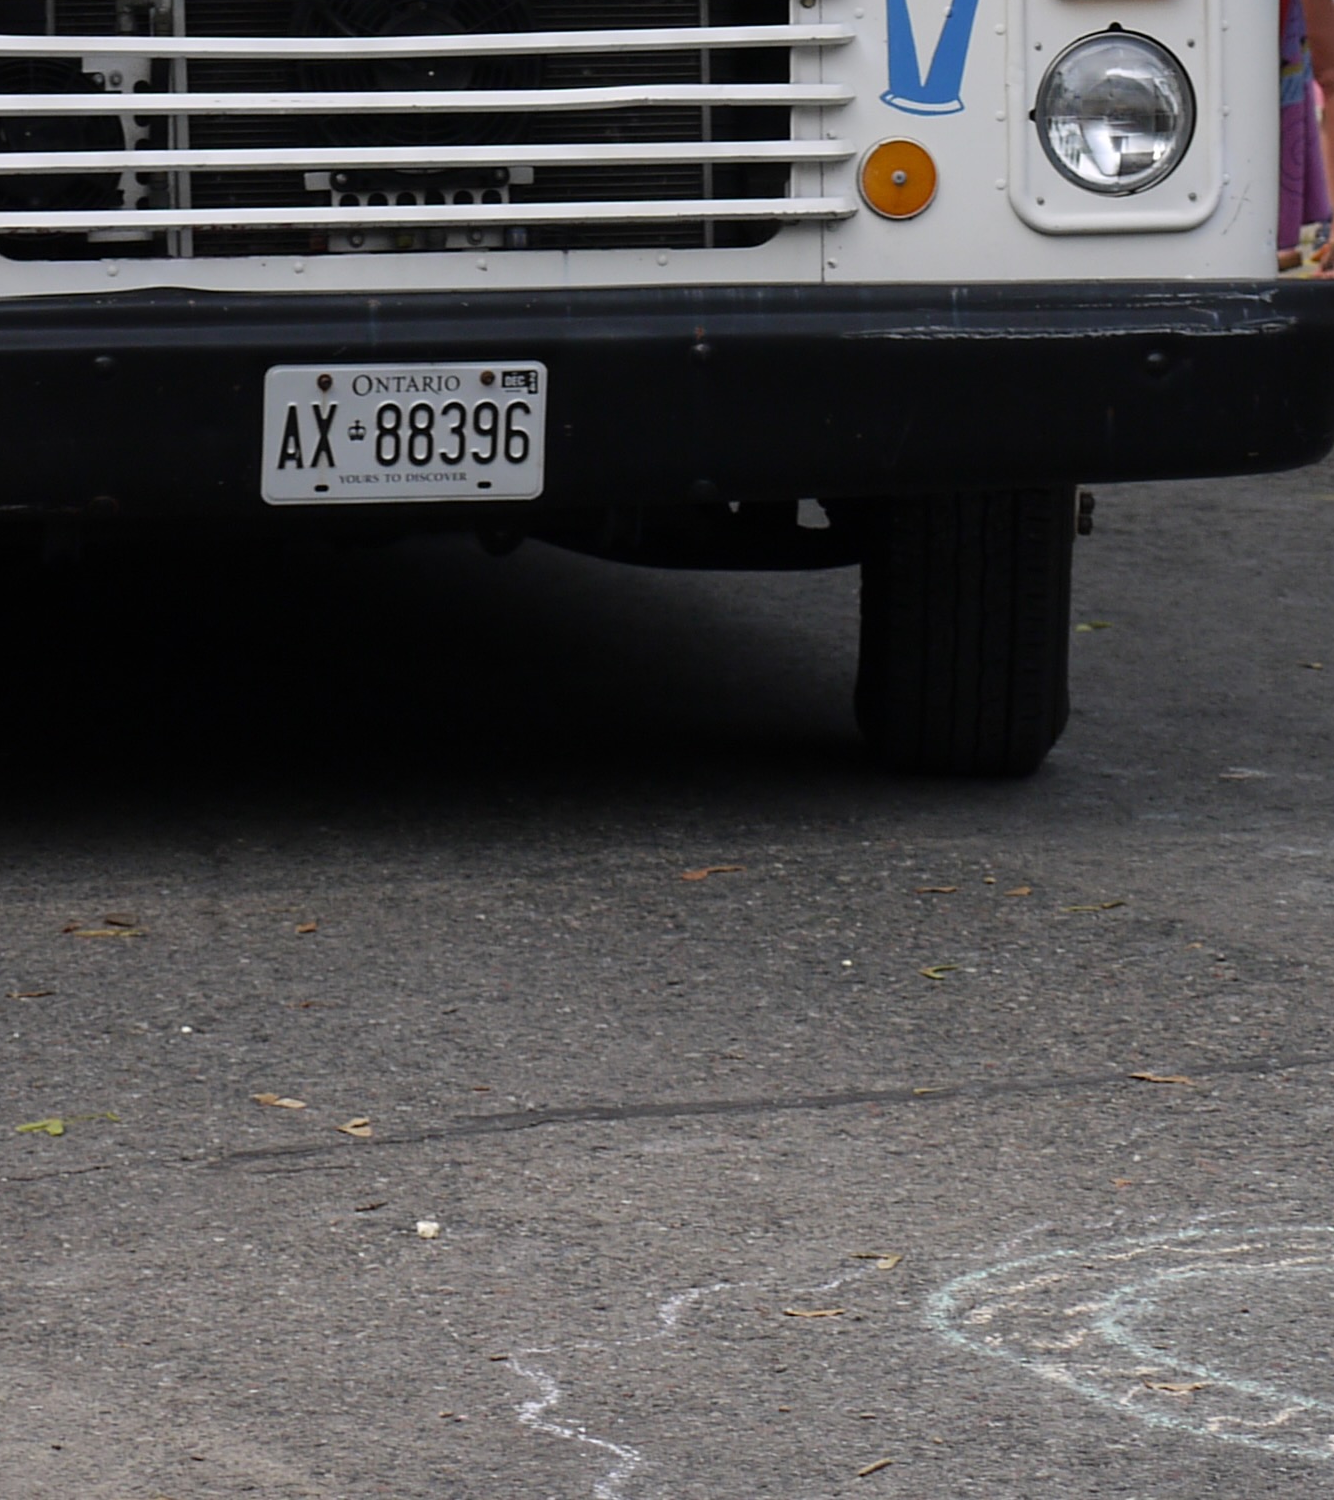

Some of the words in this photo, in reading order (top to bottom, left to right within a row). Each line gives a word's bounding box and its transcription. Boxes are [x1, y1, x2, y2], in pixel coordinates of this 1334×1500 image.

[277, 404, 338, 469] AX
[375, 401, 532, 467] 88396
[339, 473, 380, 484] YOURS
[385, 473, 402, 483] TO
[406, 471, 467, 483] DISCOVER
